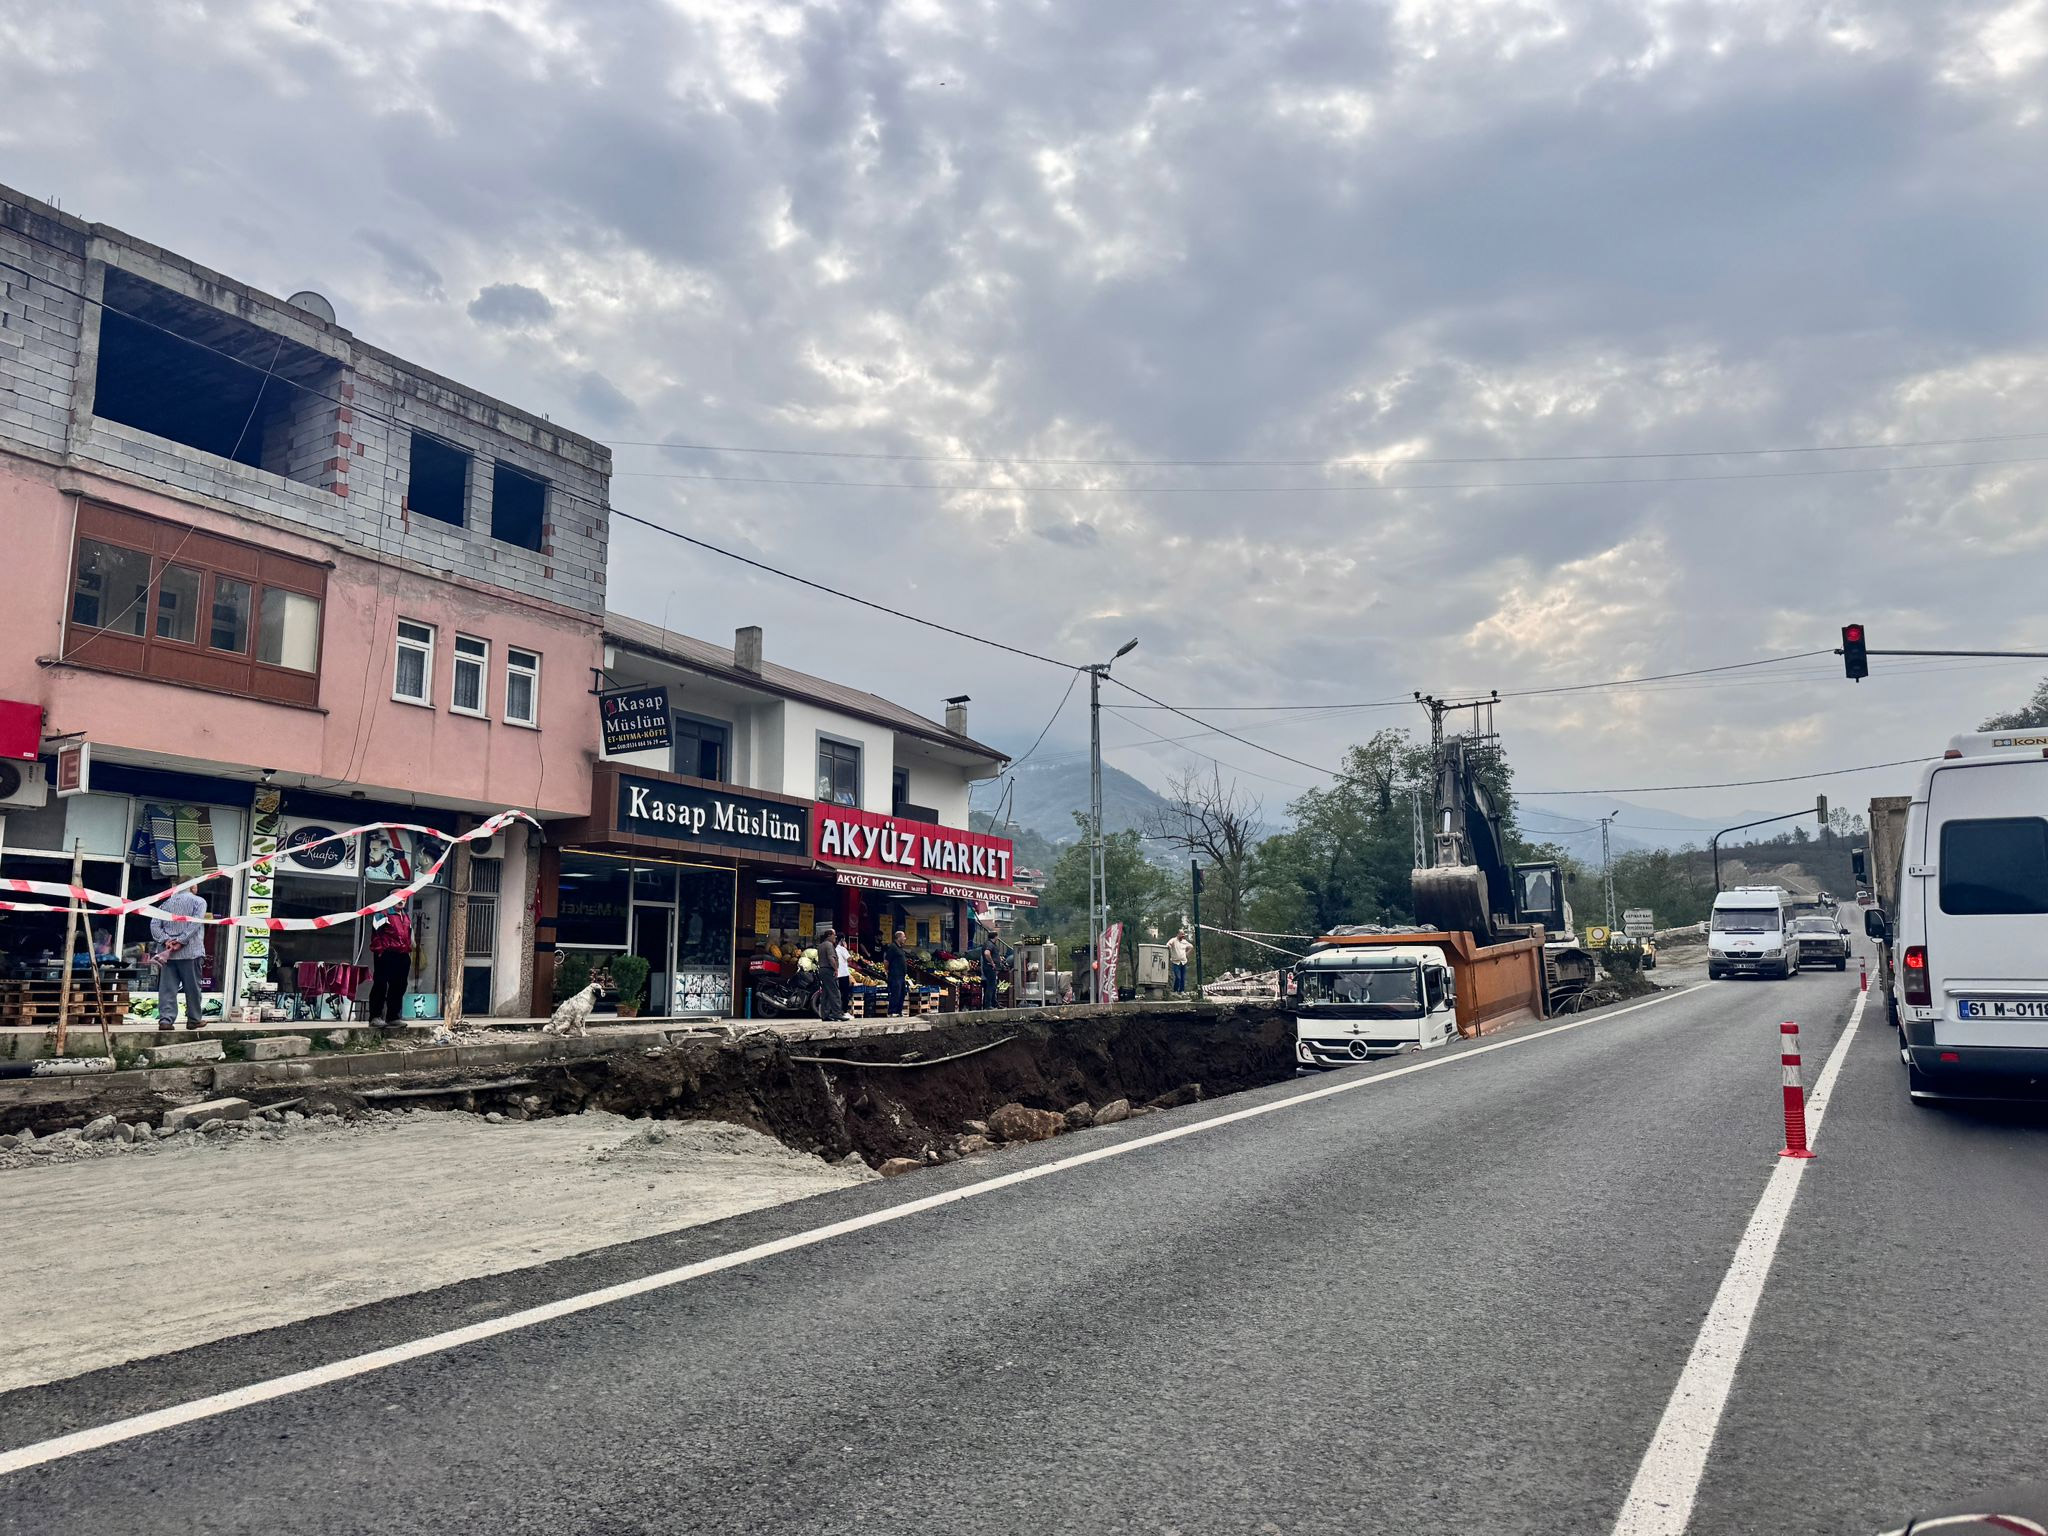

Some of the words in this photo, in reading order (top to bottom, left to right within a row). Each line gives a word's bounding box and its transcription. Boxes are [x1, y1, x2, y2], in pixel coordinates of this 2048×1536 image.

[616, 696, 663, 712] Kasap
[606, 715, 665, 733] Müslüm
[629, 786, 706, 834] Kasap
[713, 801, 801, 842] Müslüm
[301, 846, 339, 864] Kuaför
[821, 818, 916, 866] AKYÜZ
[922, 836, 1010, 880] MARKET
[837, 874, 869, 886] AKYÜZ
[872, 878, 908, 890] MARKET
[942, 886, 974, 898] AKYÜZ
[976, 891, 1011, 903] MARKET
[1969, 1002, 1986, 1016] 61
[1994, 1002, 2006, 1016] M
